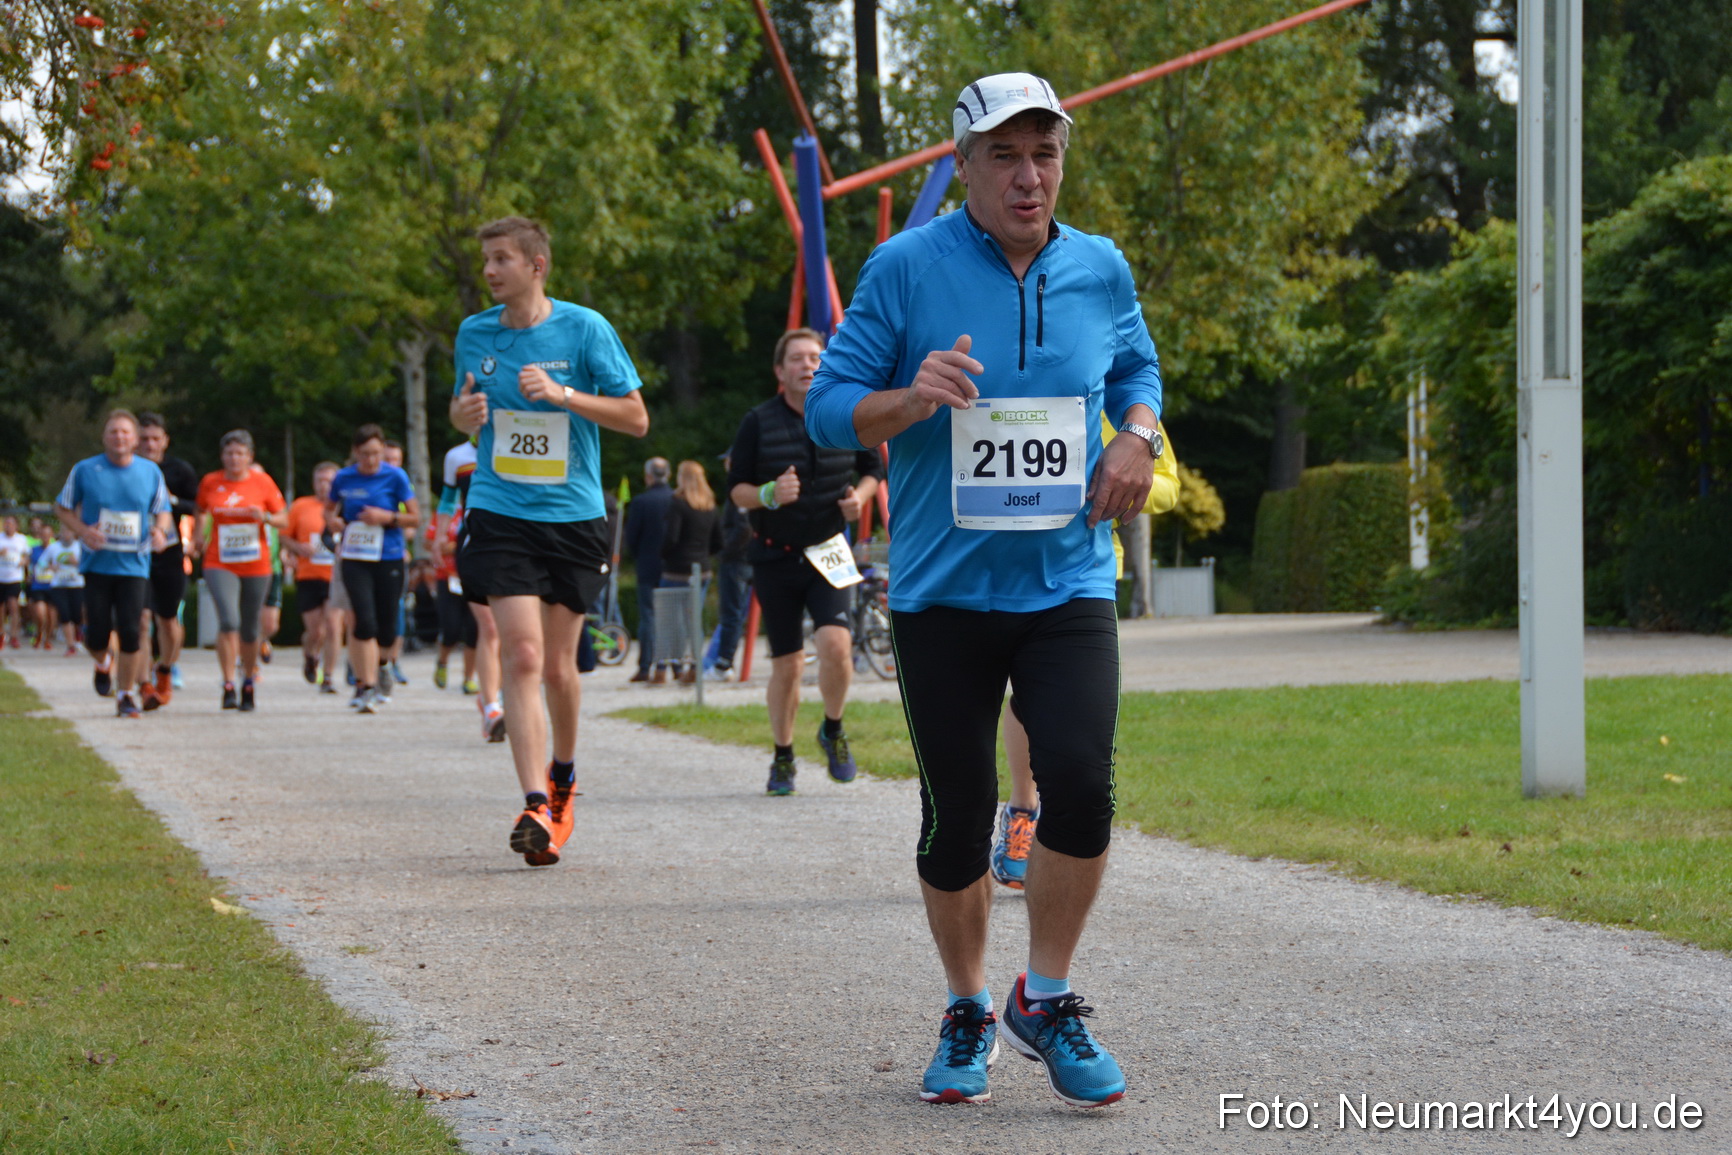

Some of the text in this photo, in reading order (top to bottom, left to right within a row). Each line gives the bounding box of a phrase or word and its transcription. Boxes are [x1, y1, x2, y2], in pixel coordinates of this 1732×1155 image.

[1004, 410, 1049, 421] BOCK
[510, 433, 549, 455] 283
[972, 439, 1067, 477] 2199
[1004, 492, 1041, 506] Josef
